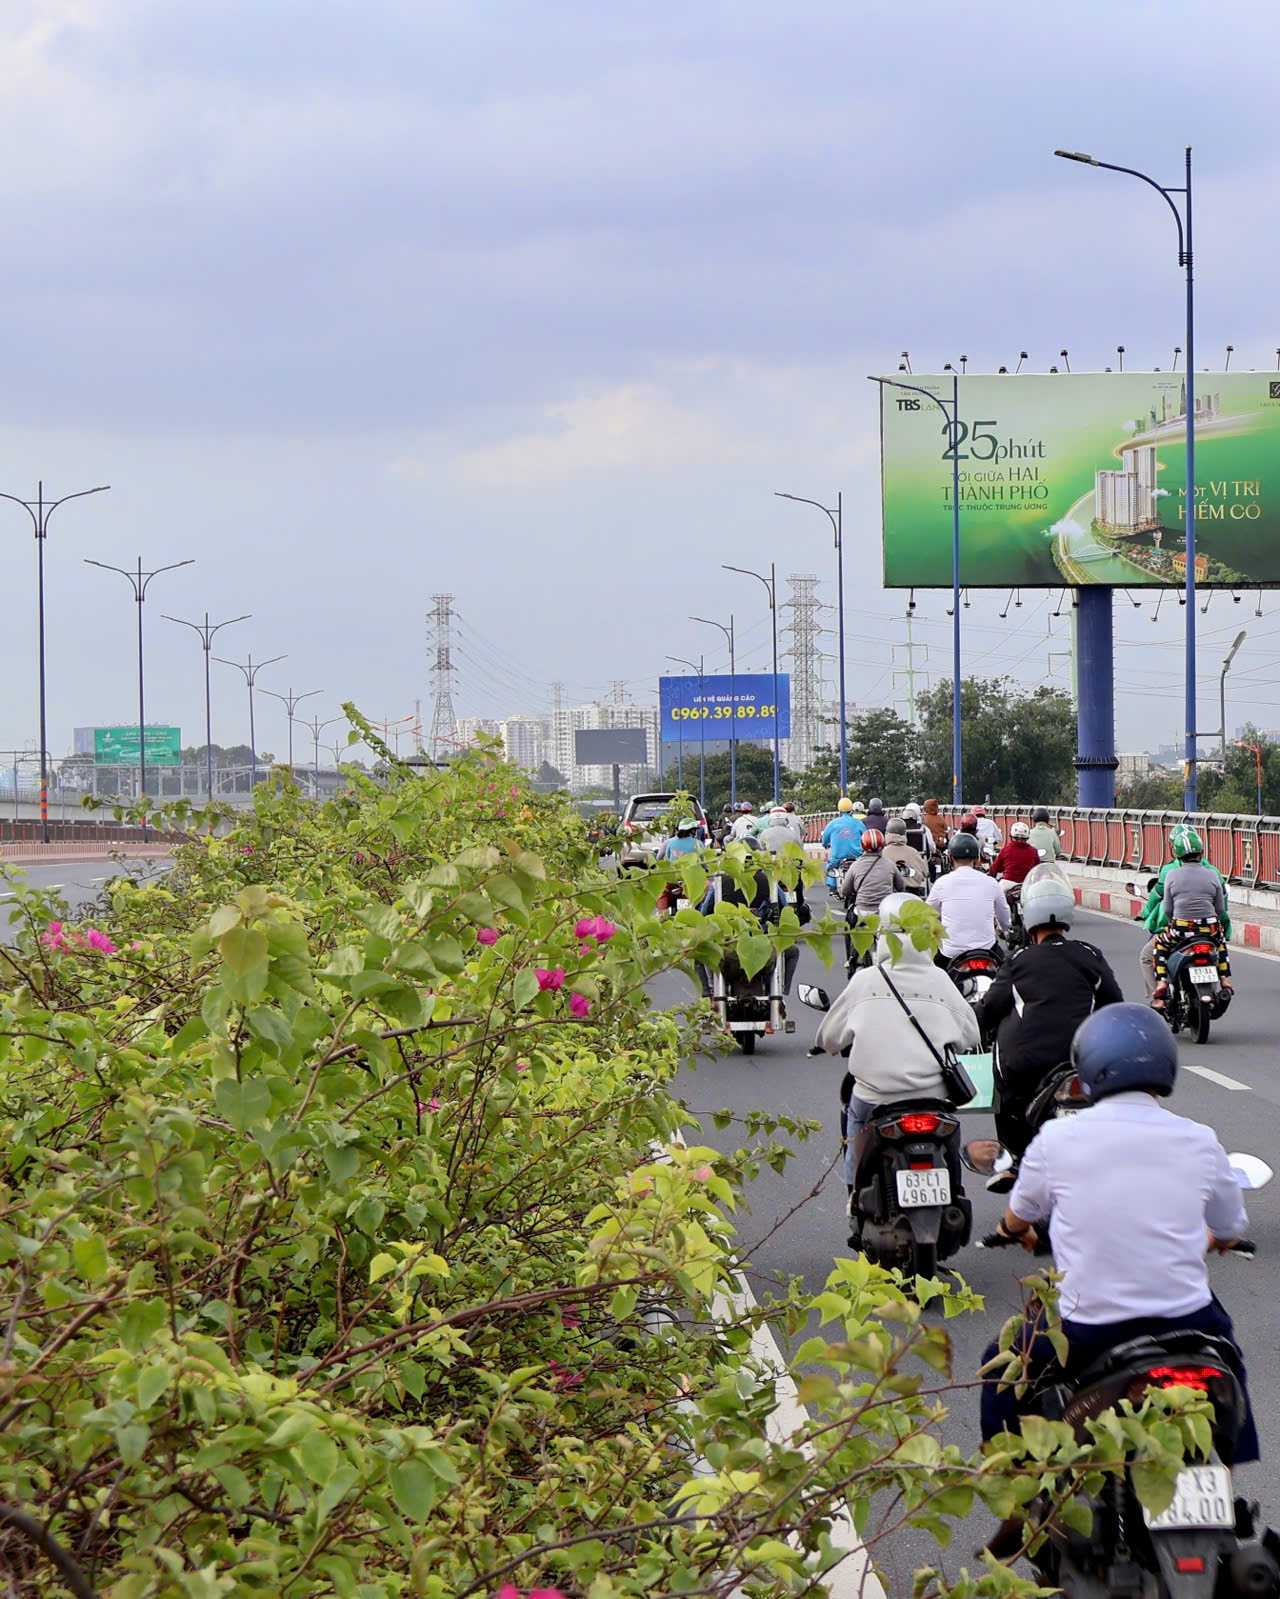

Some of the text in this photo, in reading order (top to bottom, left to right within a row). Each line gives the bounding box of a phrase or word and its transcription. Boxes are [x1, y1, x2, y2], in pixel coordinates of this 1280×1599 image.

[896, 399, 920, 411] TBS
[942, 420, 1047, 464] 25 phút
[973, 470, 1005, 482] GIỮA
[1008, 467, 1039, 481] HAI
[941, 479, 1049, 500] THÀNH PHỐ
[1210, 480, 1228, 500] VỊ
[996, 503, 1022, 511] TRUNG
[905, 1172, 940, 1188] 63-C1
[902, 1188, 948, 1204] 496.16
